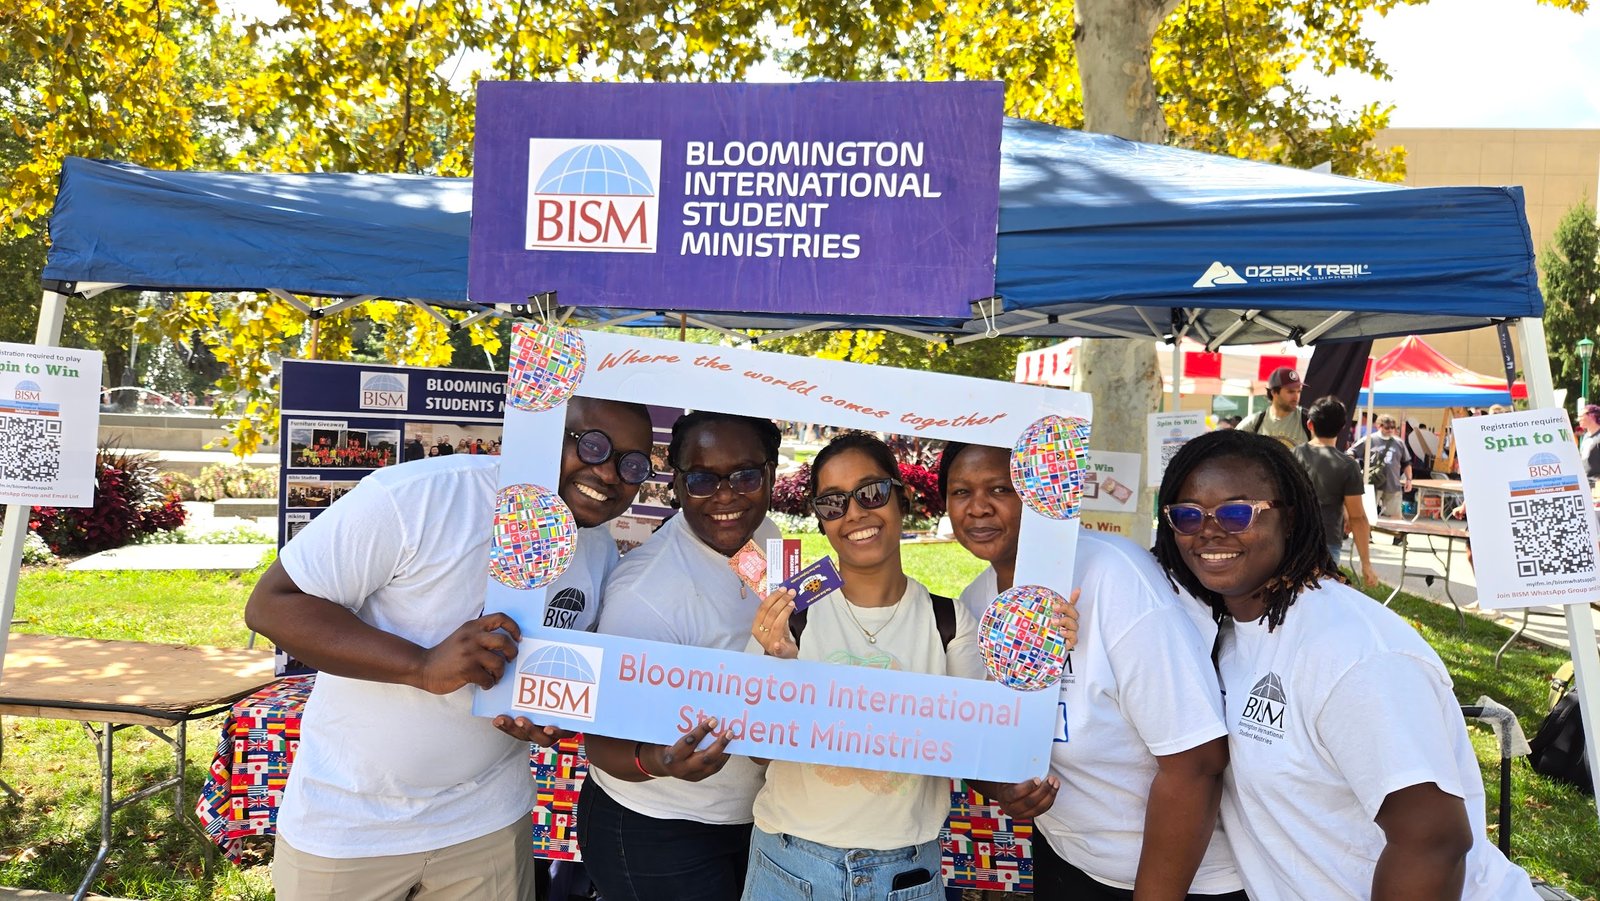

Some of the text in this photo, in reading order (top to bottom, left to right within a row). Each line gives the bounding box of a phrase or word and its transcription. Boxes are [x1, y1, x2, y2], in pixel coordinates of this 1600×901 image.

[686, 141, 924, 166] BLOOMINGTON
[684, 172, 941, 198] INTERNATIONAL
[537, 200, 648, 244] BISM
[682, 202, 829, 228] STUDENT
[680, 232, 860, 260] MINISTRIES
[1245, 264, 1372, 278] OZARK TRAIL
[25, 363, 40, 374] to
[46, 364, 79, 378] Win
[14, 390, 40, 401] BISM
[363, 392, 404, 407] BISM
[598, 350, 1008, 431] Where the world comes together
[426, 397, 494, 412] STUDENTS
[1480, 421, 1529, 432] Registration
[1484, 434, 1528, 452] Spin
[1533, 432, 1553, 444] to
[1094, 464, 1114, 472] Win
[1529, 464, 1562, 478] BISM
[1096, 522, 1121, 532] Win
[1531, 588, 1566, 597] WhatsApp
[543, 608, 579, 630] BISM
[518, 677, 592, 714] BISM
[618, 652, 1022, 728] Bloomington International
[810, 720, 954, 763] Ministries
